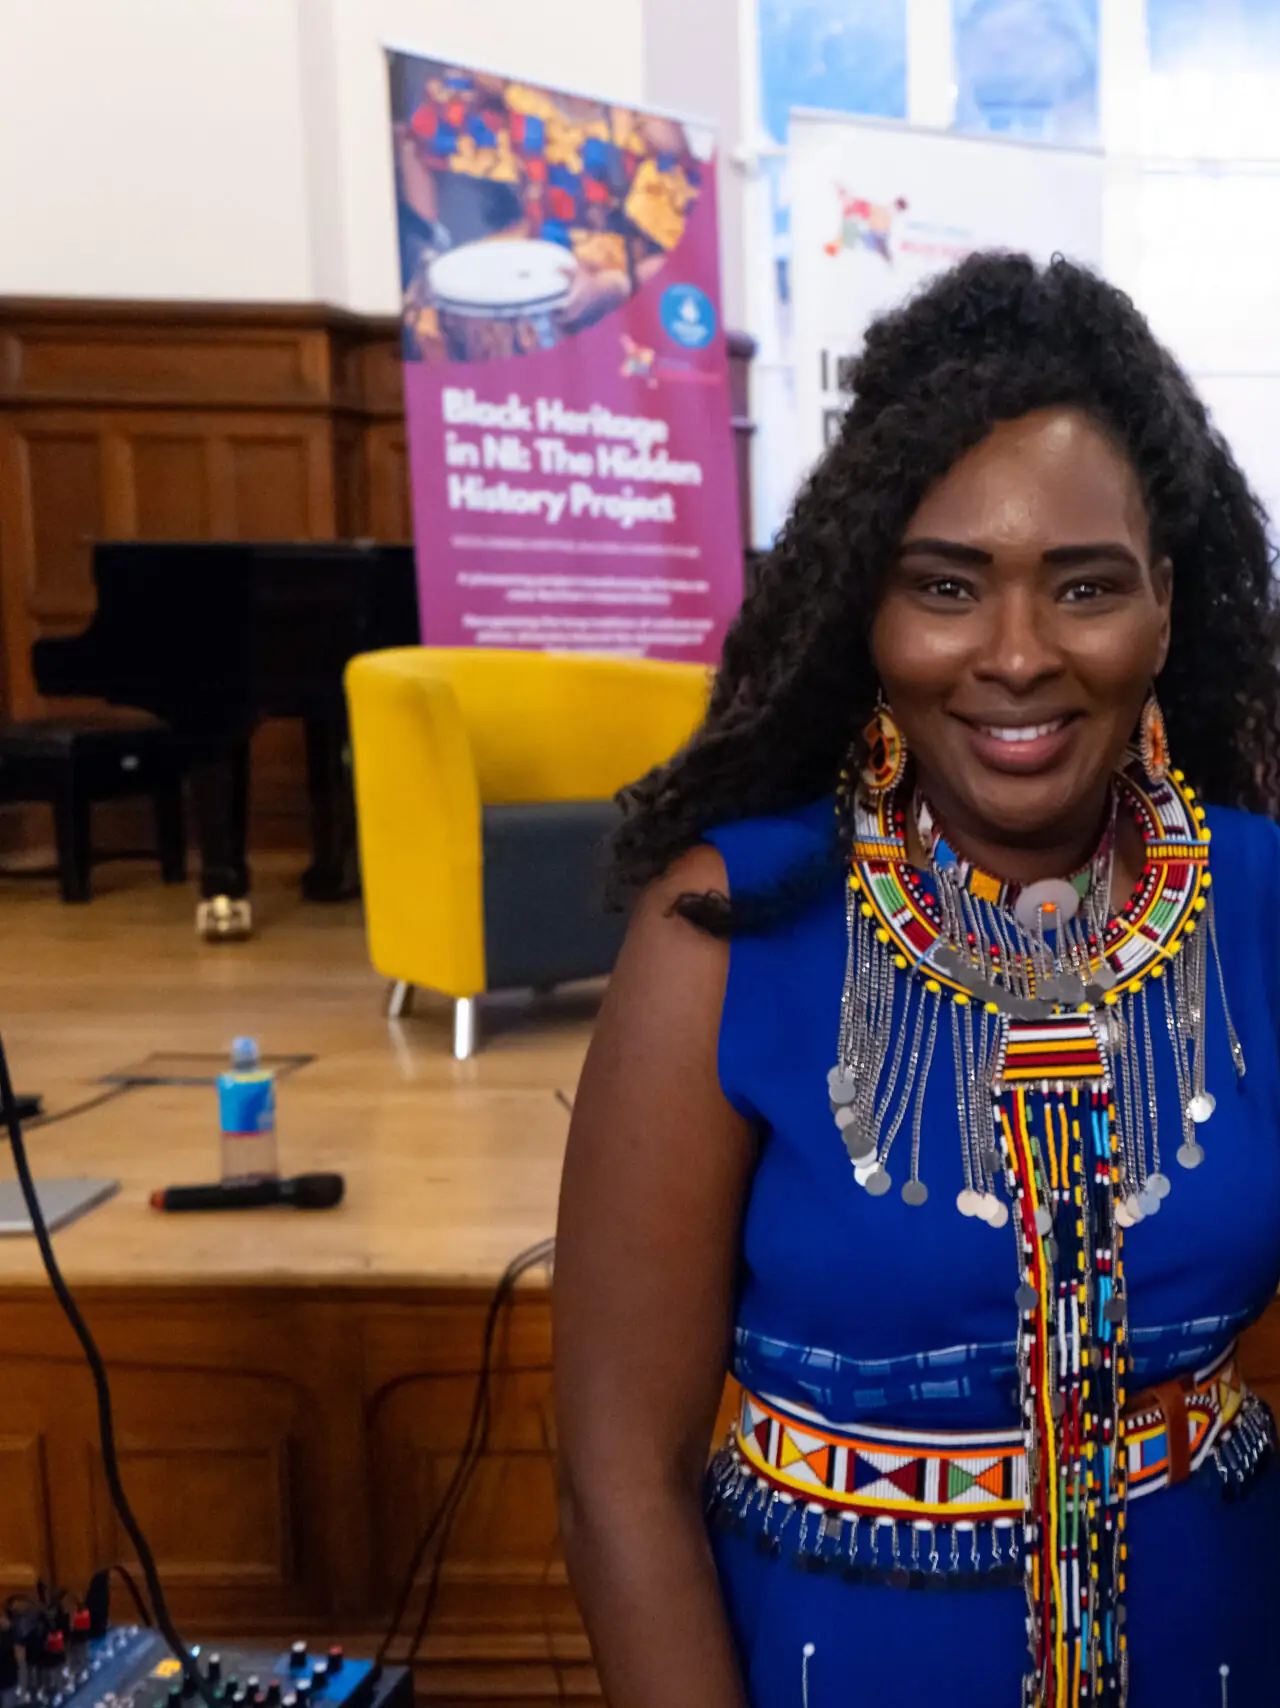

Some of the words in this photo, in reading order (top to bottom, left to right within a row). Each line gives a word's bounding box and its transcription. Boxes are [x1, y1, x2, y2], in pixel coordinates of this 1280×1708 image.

[442, 388, 531, 428] Black
[536, 398, 668, 444] Heritage
[446, 432, 479, 466] in
[534, 439, 593, 476] The
[597, 444, 701, 483] Hidden
[449, 474, 566, 522] History
[570, 482, 675, 527] Project
